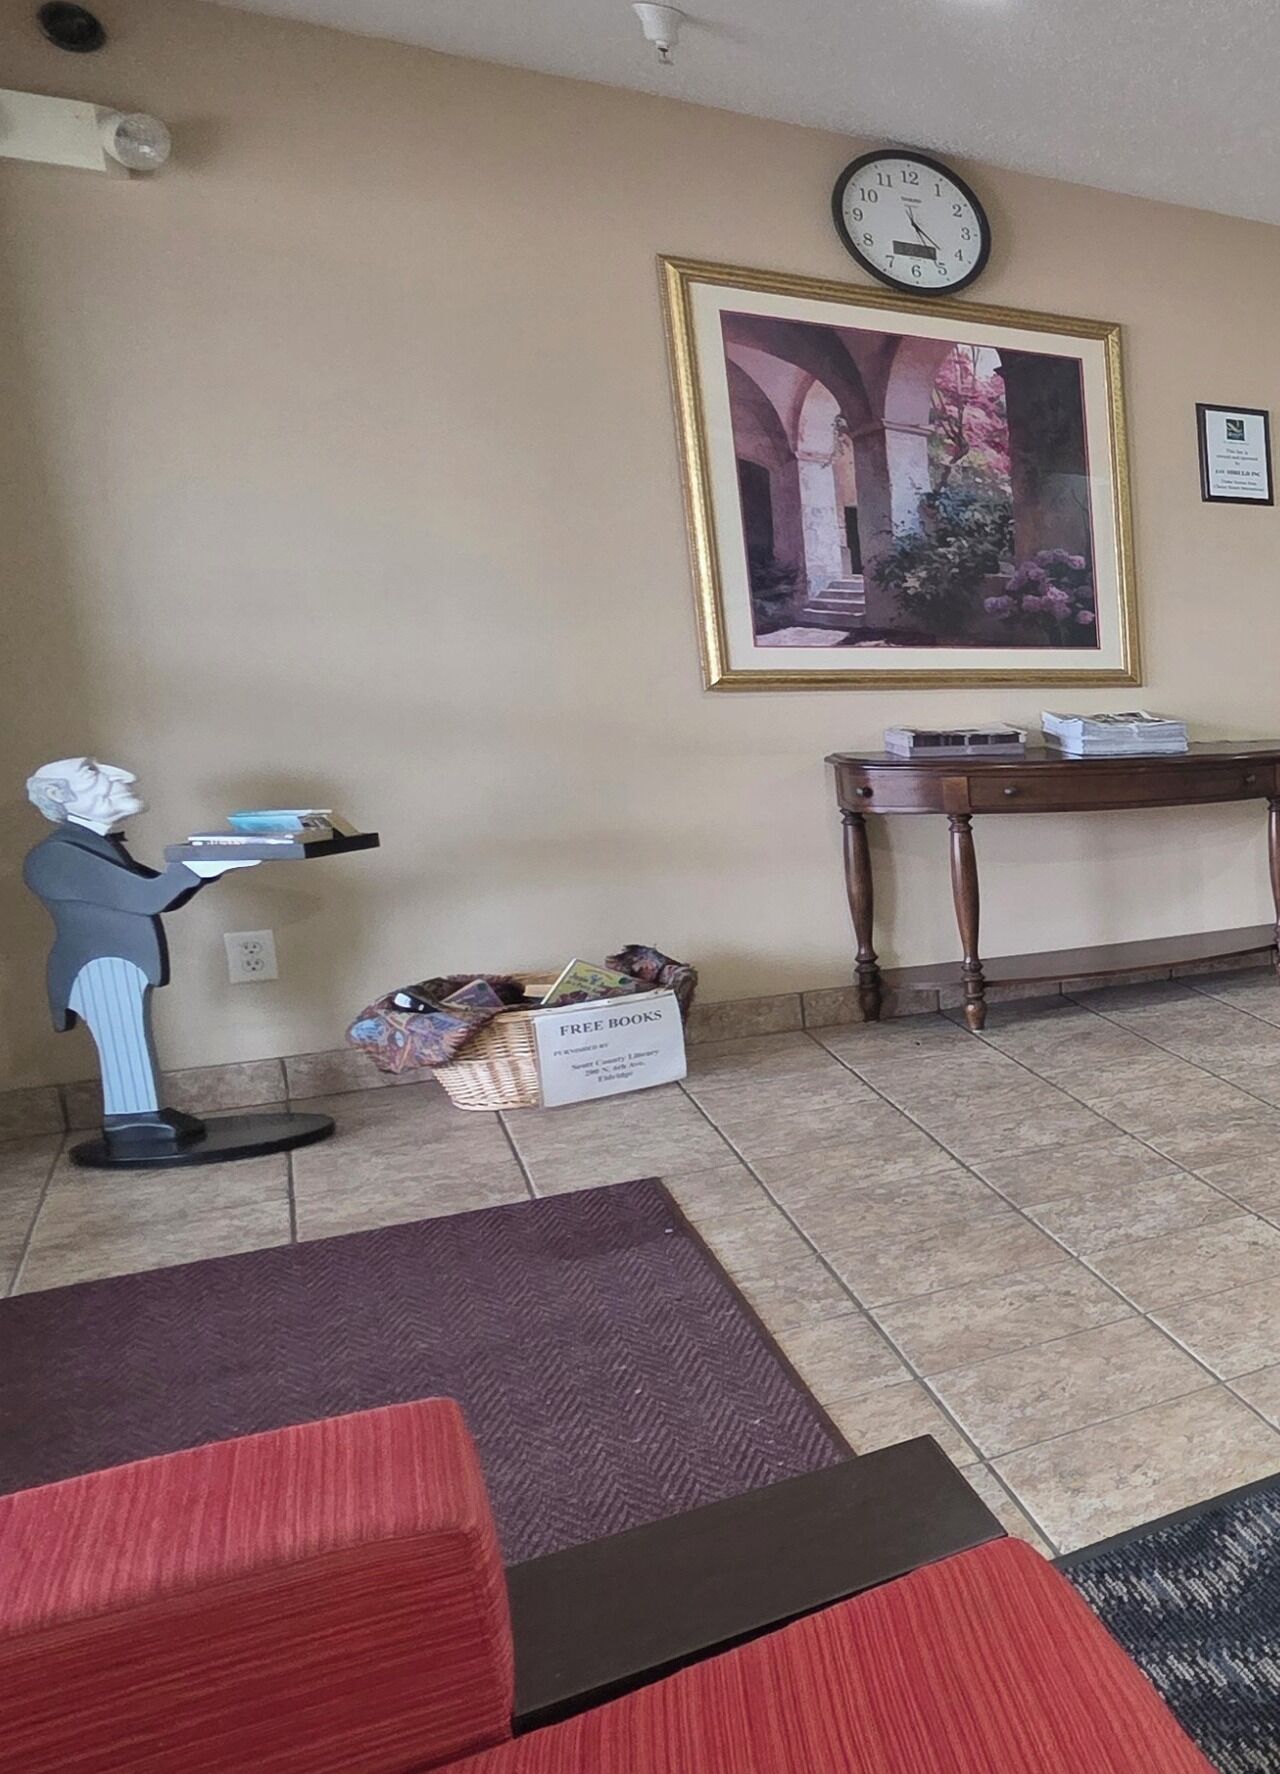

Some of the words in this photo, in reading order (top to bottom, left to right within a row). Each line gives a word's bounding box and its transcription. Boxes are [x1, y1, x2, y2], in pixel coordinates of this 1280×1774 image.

[877, 172, 893, 188] 11
[901, 170, 920, 186] 12
[859, 188, 878, 203] 10
[934, 183, 941, 197] 1
[852, 207, 864, 222] 9
[952, 204, 963, 218] 2
[863, 233, 874, 247] 8
[960, 227, 971, 241] 3
[885, 255, 895, 269] 7
[954, 249, 964, 262] 4
[911, 266, 922, 278] 6
[937, 262, 948, 276] 5
[560, 1020, 604, 1037] FREE
[608, 1009, 663, 1029] BOOKS
